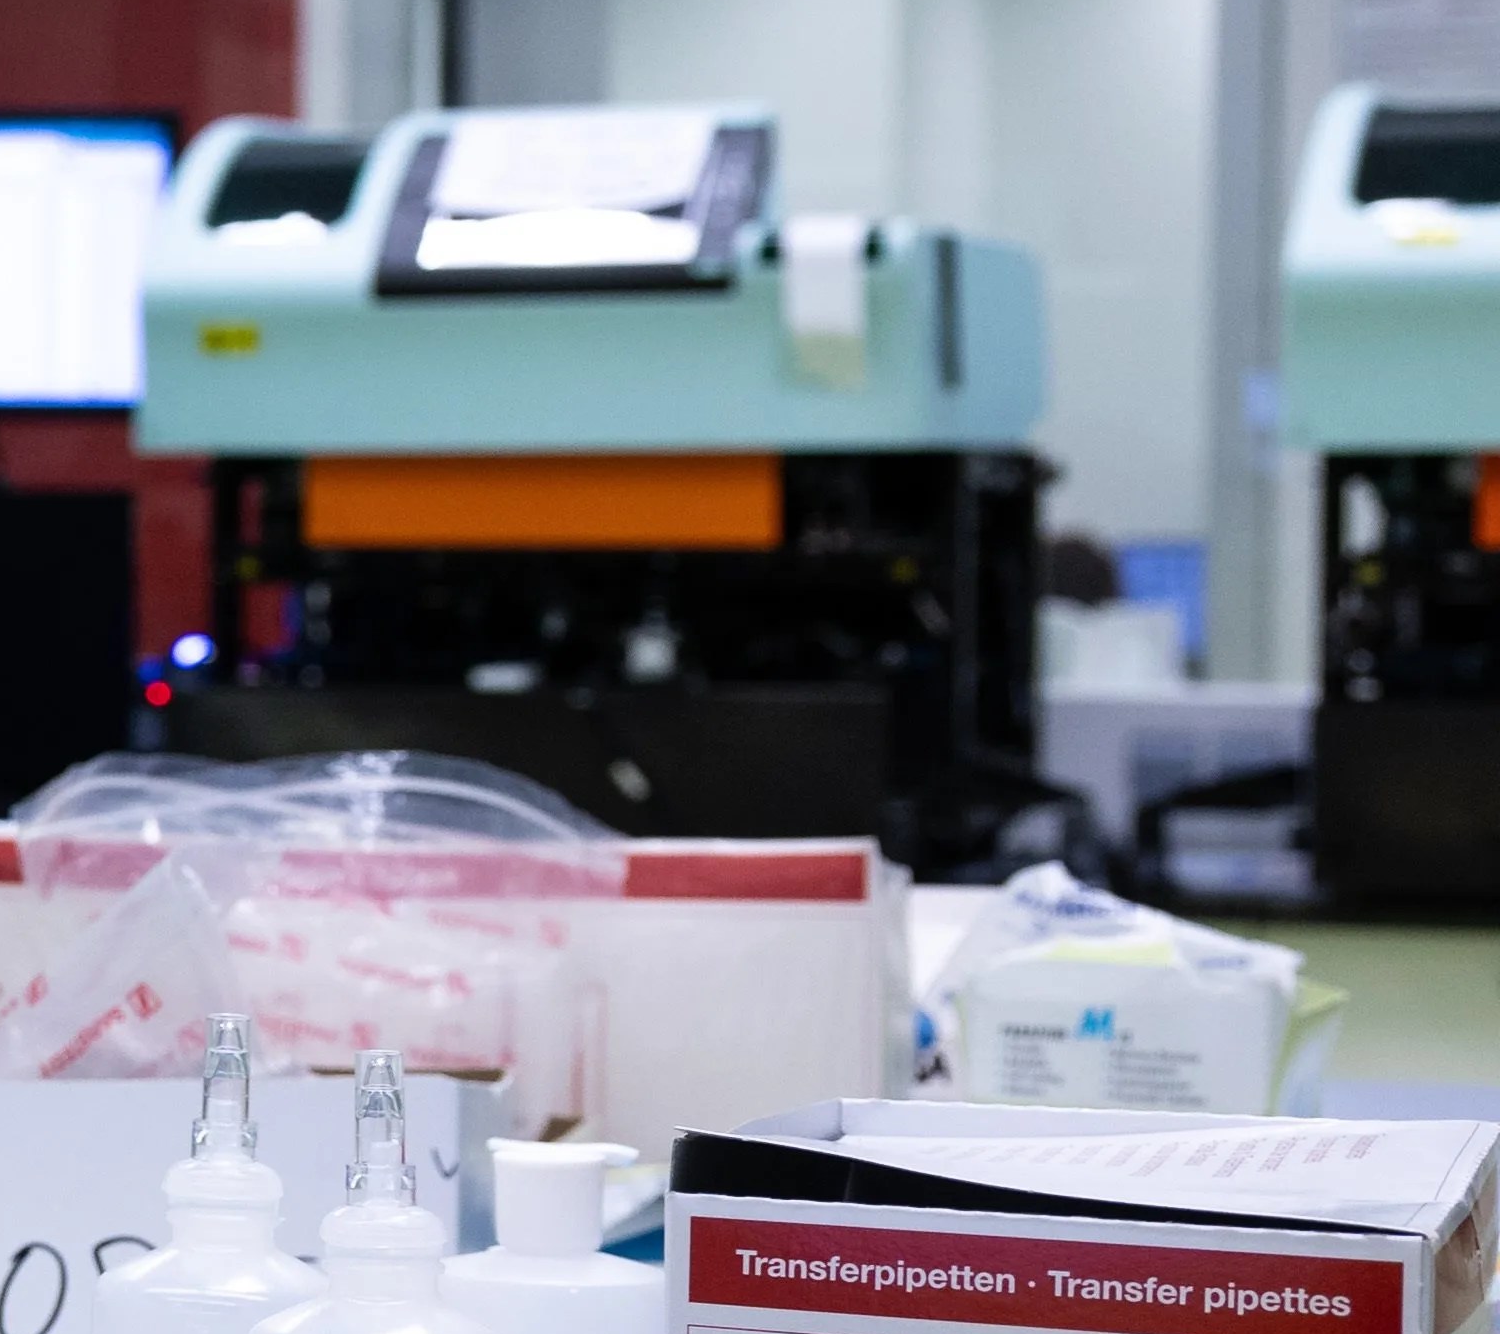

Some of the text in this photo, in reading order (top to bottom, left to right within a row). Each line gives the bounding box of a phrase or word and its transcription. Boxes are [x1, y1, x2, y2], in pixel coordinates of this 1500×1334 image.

[735, 1248, 1352, 1317] Transferpipetten Transfer pipettes
